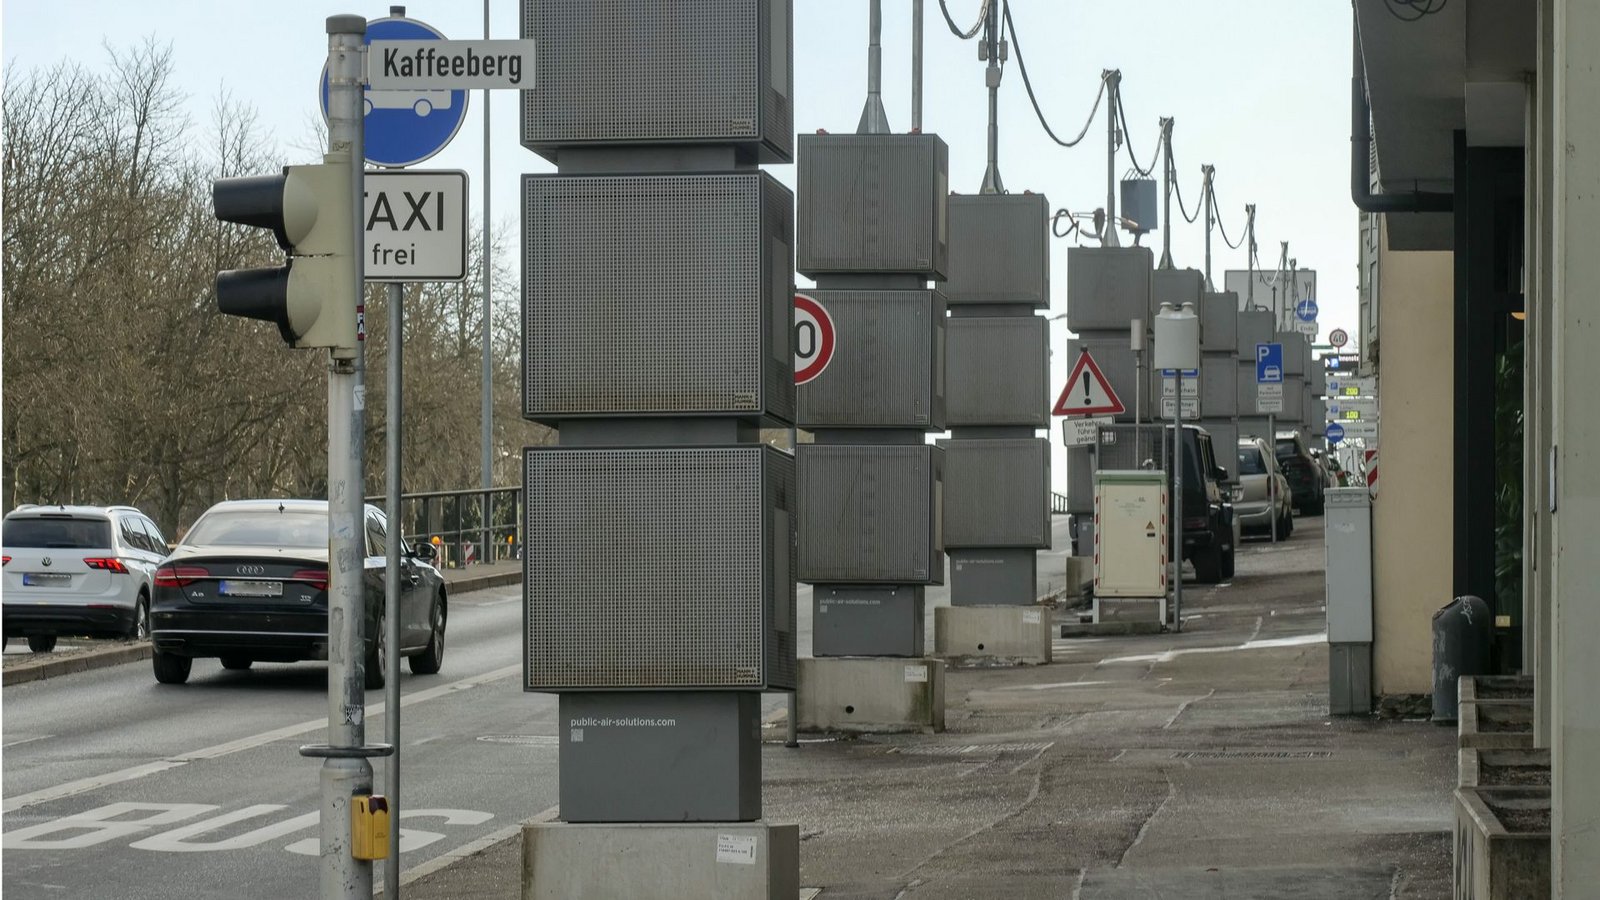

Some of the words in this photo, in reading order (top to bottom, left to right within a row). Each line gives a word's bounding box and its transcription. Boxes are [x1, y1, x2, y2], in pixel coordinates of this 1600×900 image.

[384, 48, 522, 84] Kaffeeberg
[364, 192, 444, 231] AXI
[372, 243, 415, 265] frei
[795, 320, 816, 359] 0
[1334, 334, 1345, 342] 40
[1258, 346, 1270, 362] P
[1077, 436, 1096, 444] geänd
[570, 717, 676, 727] public-air-solutions.com
